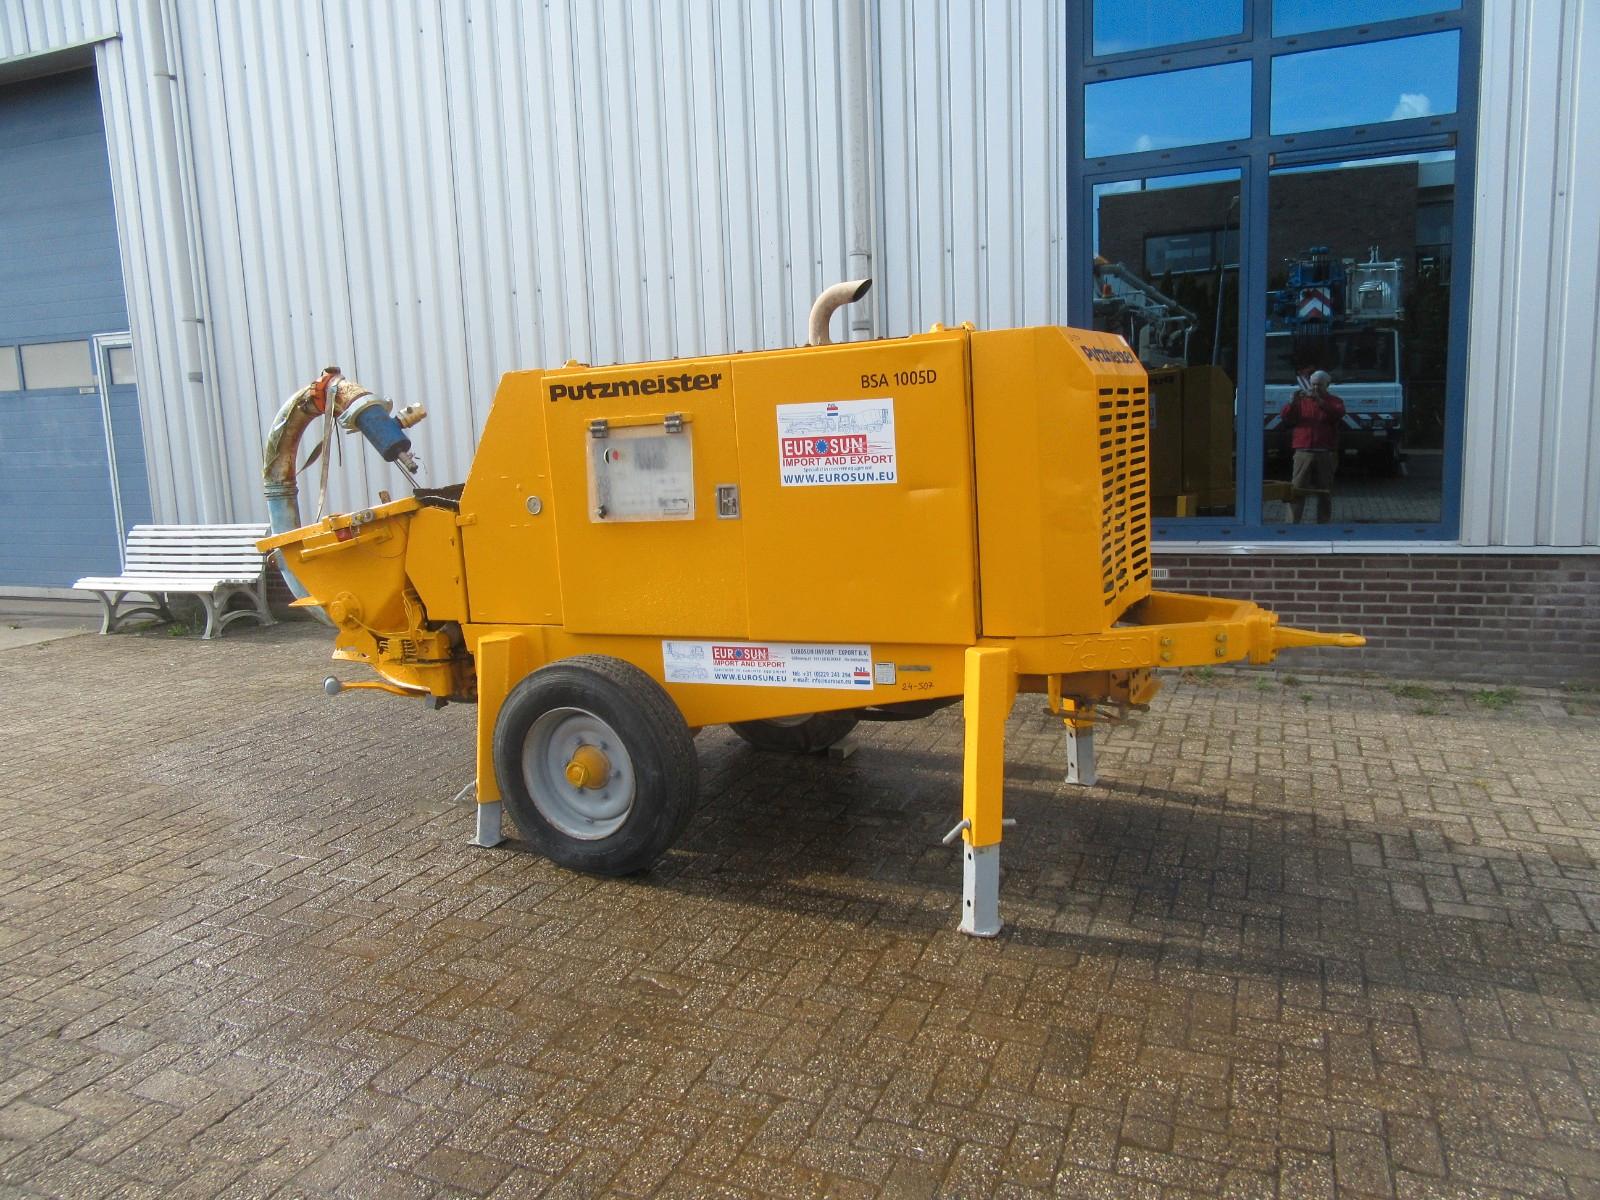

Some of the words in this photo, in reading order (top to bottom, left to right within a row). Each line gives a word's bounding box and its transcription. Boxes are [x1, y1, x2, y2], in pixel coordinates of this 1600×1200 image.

[861, 373, 889, 389] BSA
[894, 369, 937, 387] 1005D
[549, 373, 722, 402] Putzmeister
[783, 457, 821, 467] IMPORT
[824, 456, 847, 466] AND
[850, 455, 894, 465] EXPORT
[783, 471, 894, 484] WWW.EUROSUN.EU
[714, 673, 787, 682] WWW.EUROSUN.EU
